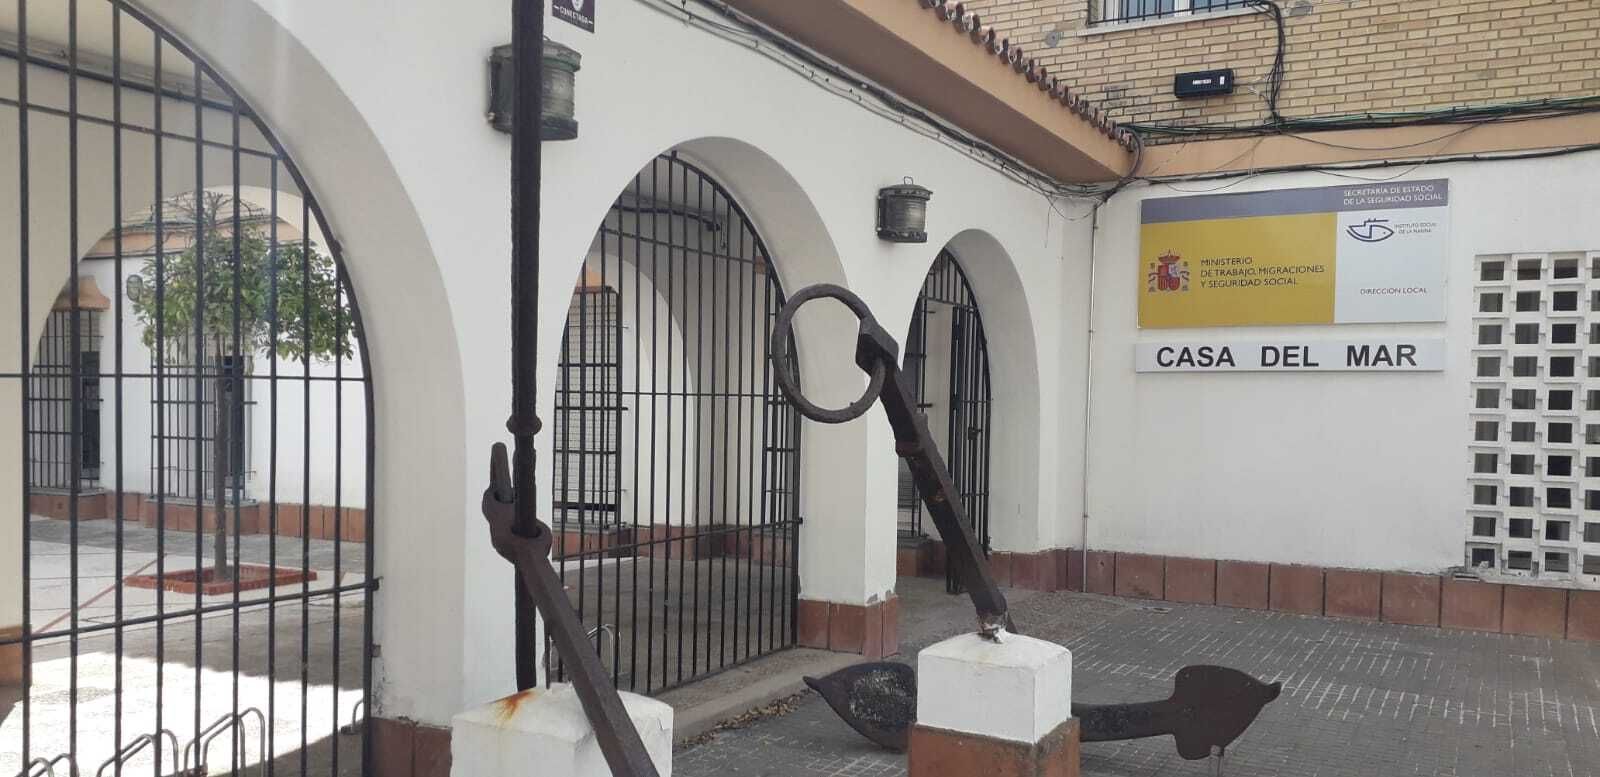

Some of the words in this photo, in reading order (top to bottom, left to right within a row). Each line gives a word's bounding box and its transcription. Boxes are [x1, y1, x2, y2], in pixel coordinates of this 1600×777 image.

[1402, 185, 1434, 193] ESTADO
[1367, 195, 1411, 204] SEGURIDAD
[1413, 192, 1442, 201] SOCIAL
[1200, 256, 1252, 266] MINISTERIO
[1200, 269, 1214, 277] DE
[1215, 267, 1256, 277] TRABAJO,
[1258, 264, 1325, 275] MIGRACIONES
[1200, 280, 1206, 288] Y
[1208, 278, 1261, 288] SEGURIDAD
[1264, 277, 1297, 286] SOCIAL
[1156, 346, 1236, 368] CASA
[1260, 345, 1319, 367] DEL
[1346, 344, 1417, 367] MAR
